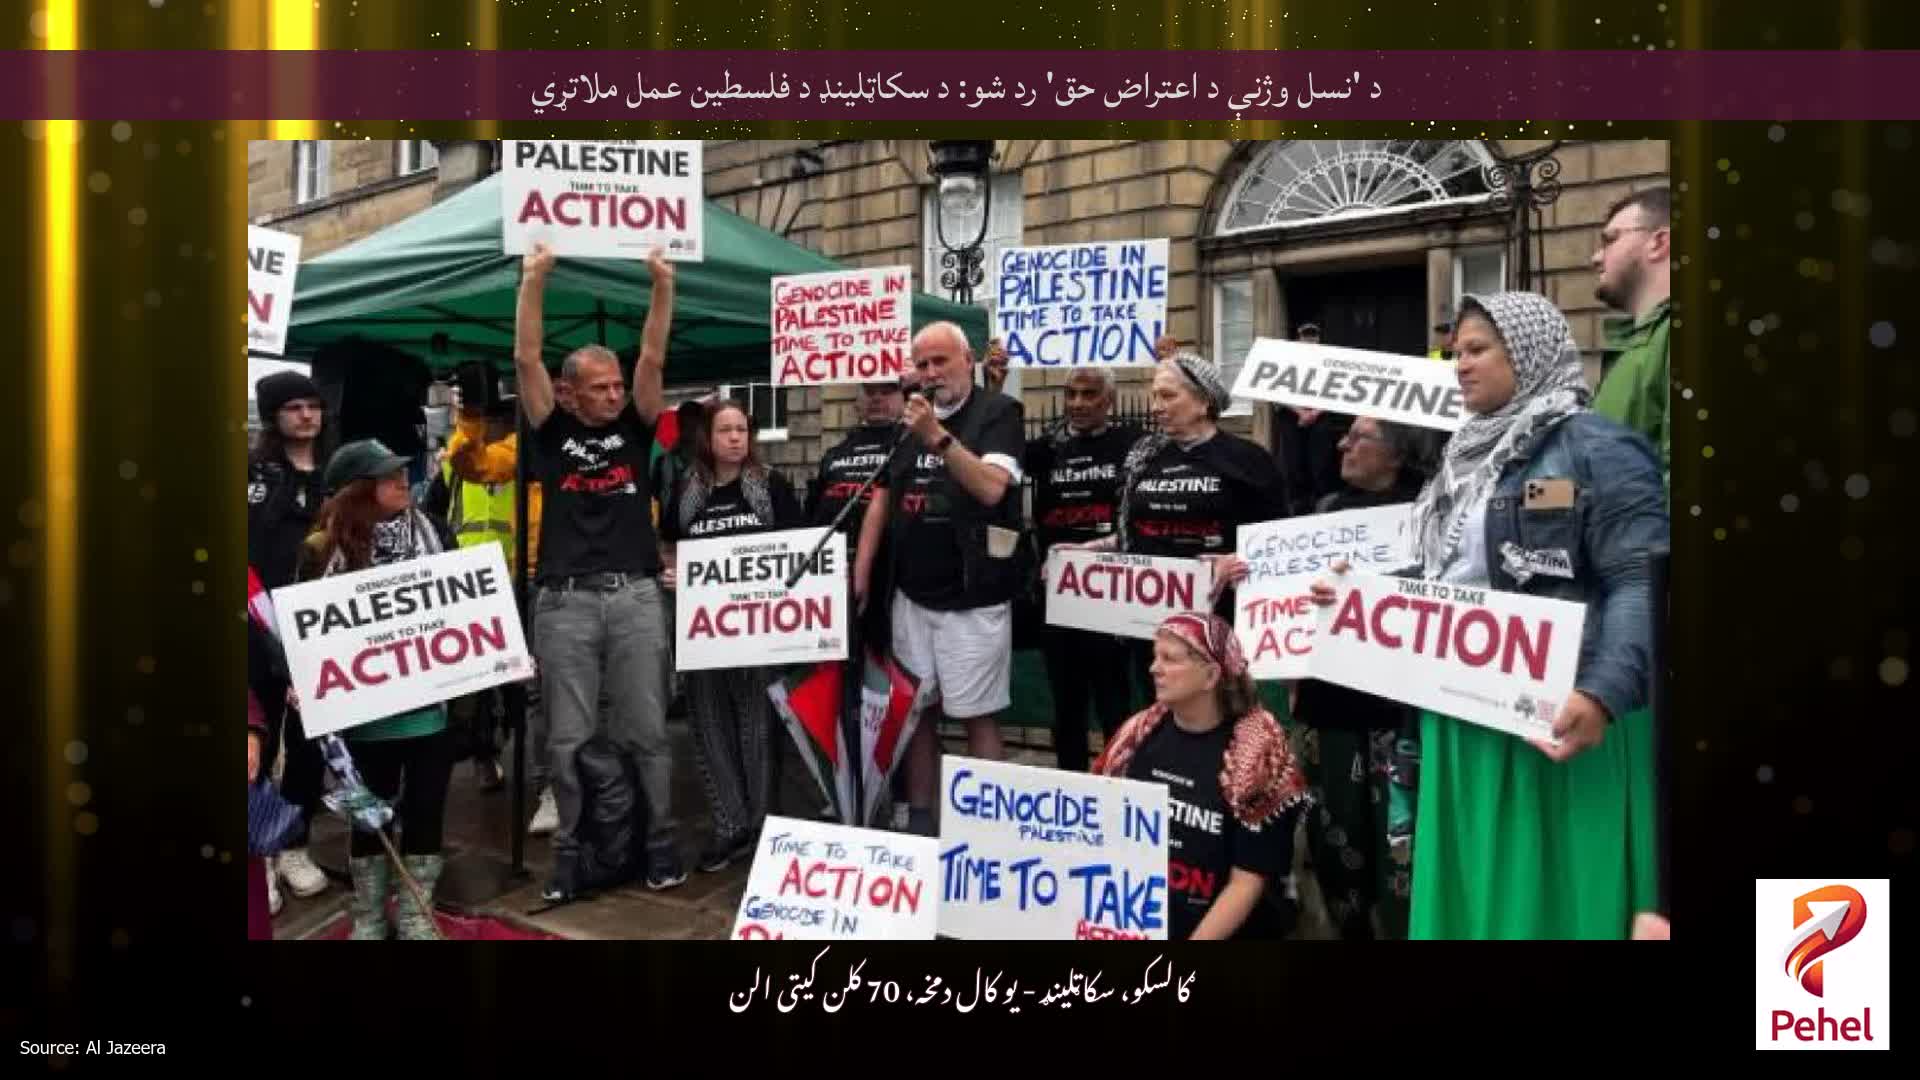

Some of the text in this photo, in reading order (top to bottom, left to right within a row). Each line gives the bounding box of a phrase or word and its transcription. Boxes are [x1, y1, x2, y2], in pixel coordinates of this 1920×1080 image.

[515, 142, 690, 177] PALESTINE
[517, 189, 687, 231] ACTION
[1001, 244, 1146, 274] GENOCIDE IN
[775, 274, 905, 306] GENOCIDE IN
[999, 264, 1167, 308] PALESTINE
[998, 302, 1137, 331] TIME TO TAKE
[773, 327, 909, 355] TIME TO TAKE
[1006, 320, 1163, 366] ACTION
[779, 348, 905, 384] ACTION
[1249, 360, 1464, 419] PALESTINE
[686, 547, 835, 588] PALESTINE
[1056, 560, 1194, 611] ACTION
[294, 567, 497, 640] PALESTINE
[1244, 595, 1313, 629] TIME
[1431, 583, 1450, 600] TO
[1453, 588, 1488, 607] TAKE
[687, 595, 833, 640] ACTION
[1329, 588, 1554, 681] ACTION
[315, 615, 507, 700] ACTION
[769, 831, 812, 856] TIME
[823, 842, 848, 860] TO
[1009, 856, 1058, 912] TO
[1068, 863, 1167, 932] TAKE
[831, 907, 858, 935] IN
